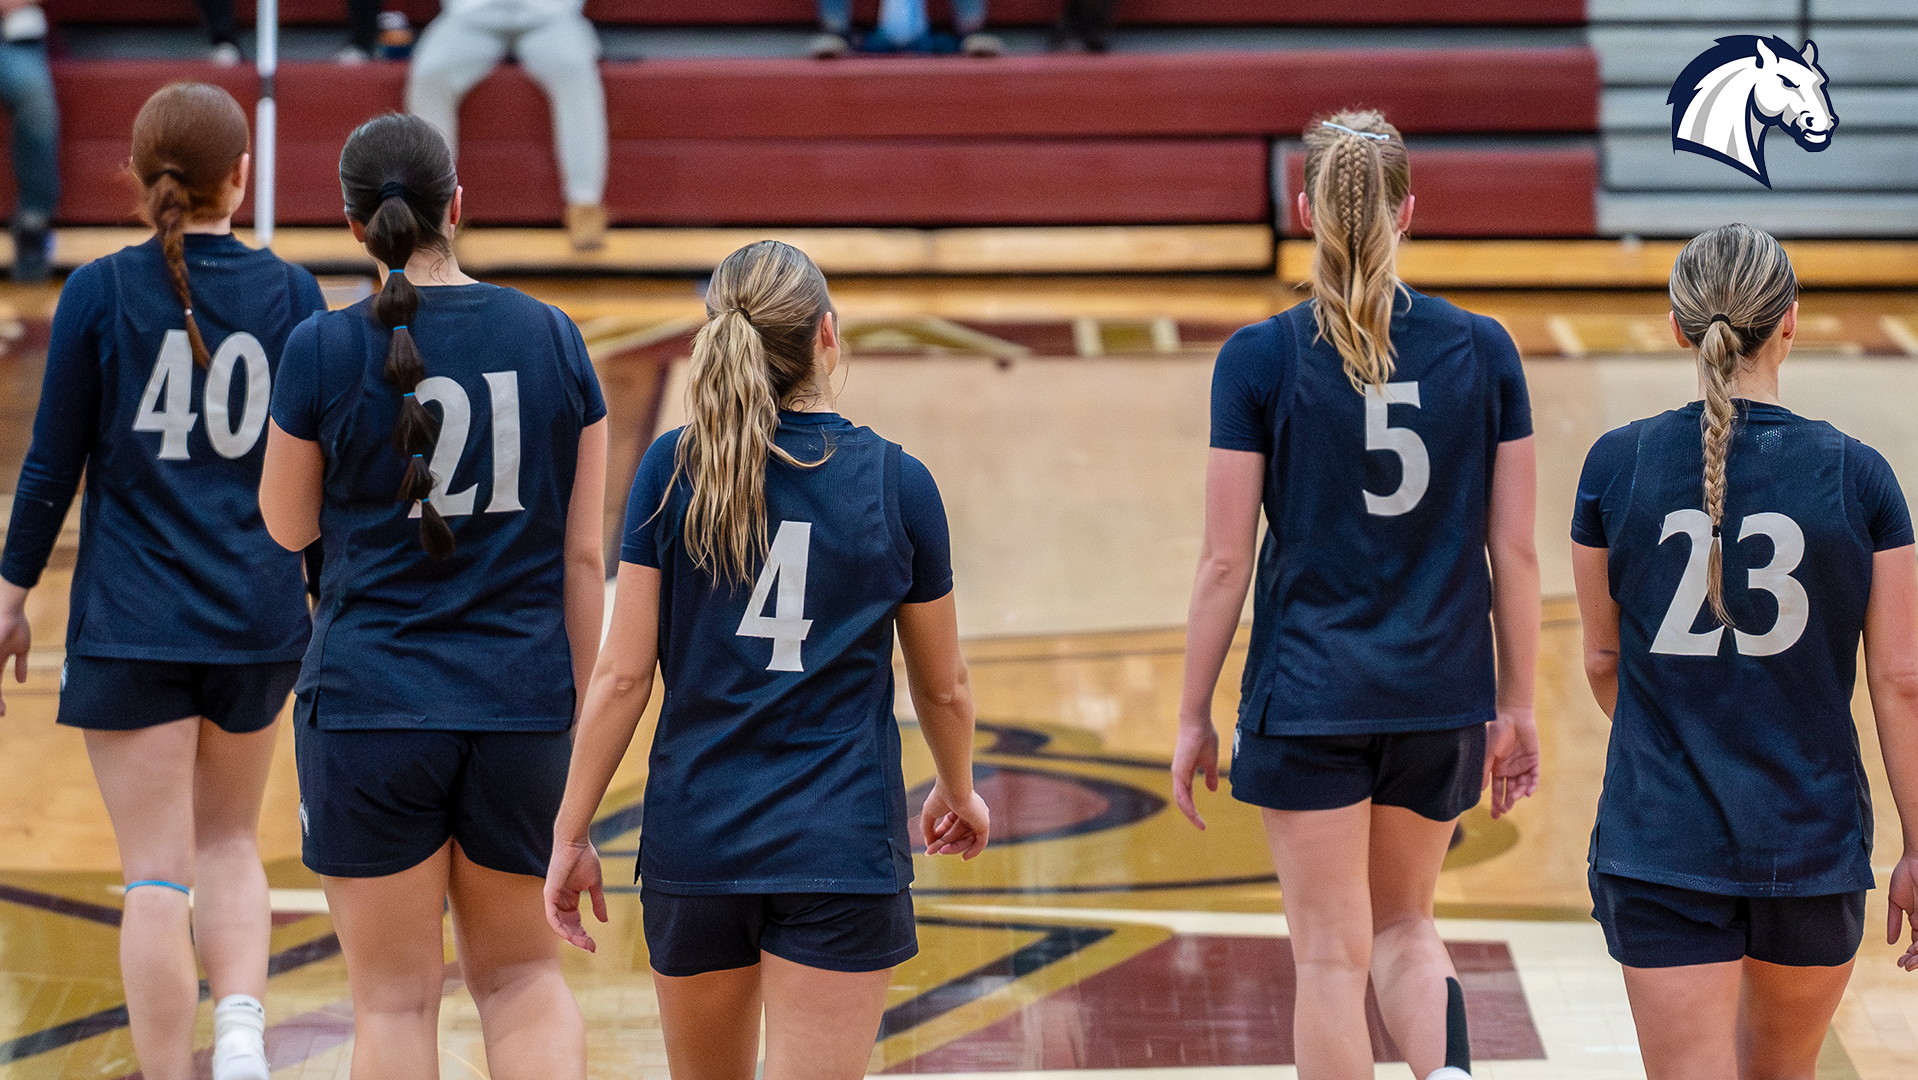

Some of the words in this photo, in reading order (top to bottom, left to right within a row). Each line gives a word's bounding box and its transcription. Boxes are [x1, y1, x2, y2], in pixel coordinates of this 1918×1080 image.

[132, 329, 271, 460] 40
[407, 371, 525, 518] 21
[1362, 381, 1430, 517] 5
[735, 520, 813, 672] 4
[1649, 509, 1810, 657] 23
